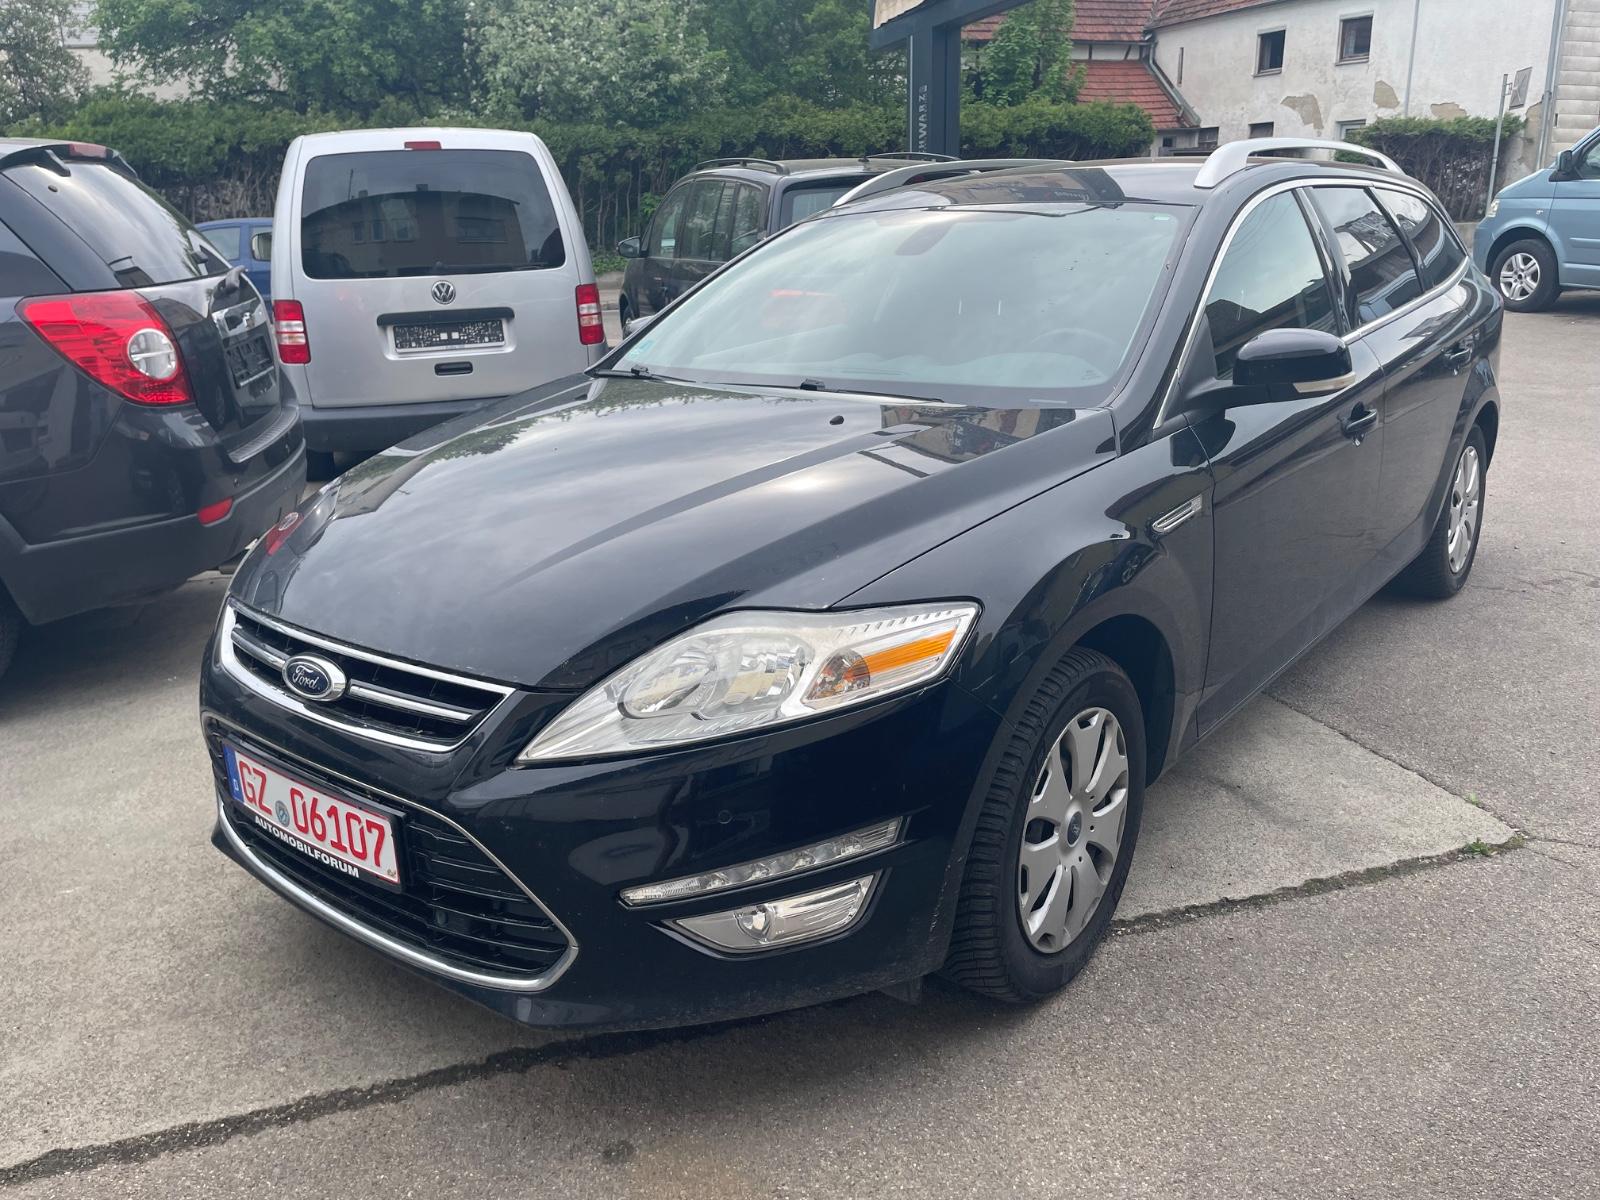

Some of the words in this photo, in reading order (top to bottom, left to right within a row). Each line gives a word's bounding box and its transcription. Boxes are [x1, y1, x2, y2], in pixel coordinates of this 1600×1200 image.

[292, 665, 319, 689] Ford
[239, 760, 273, 816] GZ
[290, 787, 386, 868] 06107
[254, 815, 360, 878] AUTOMOBILFORUM
